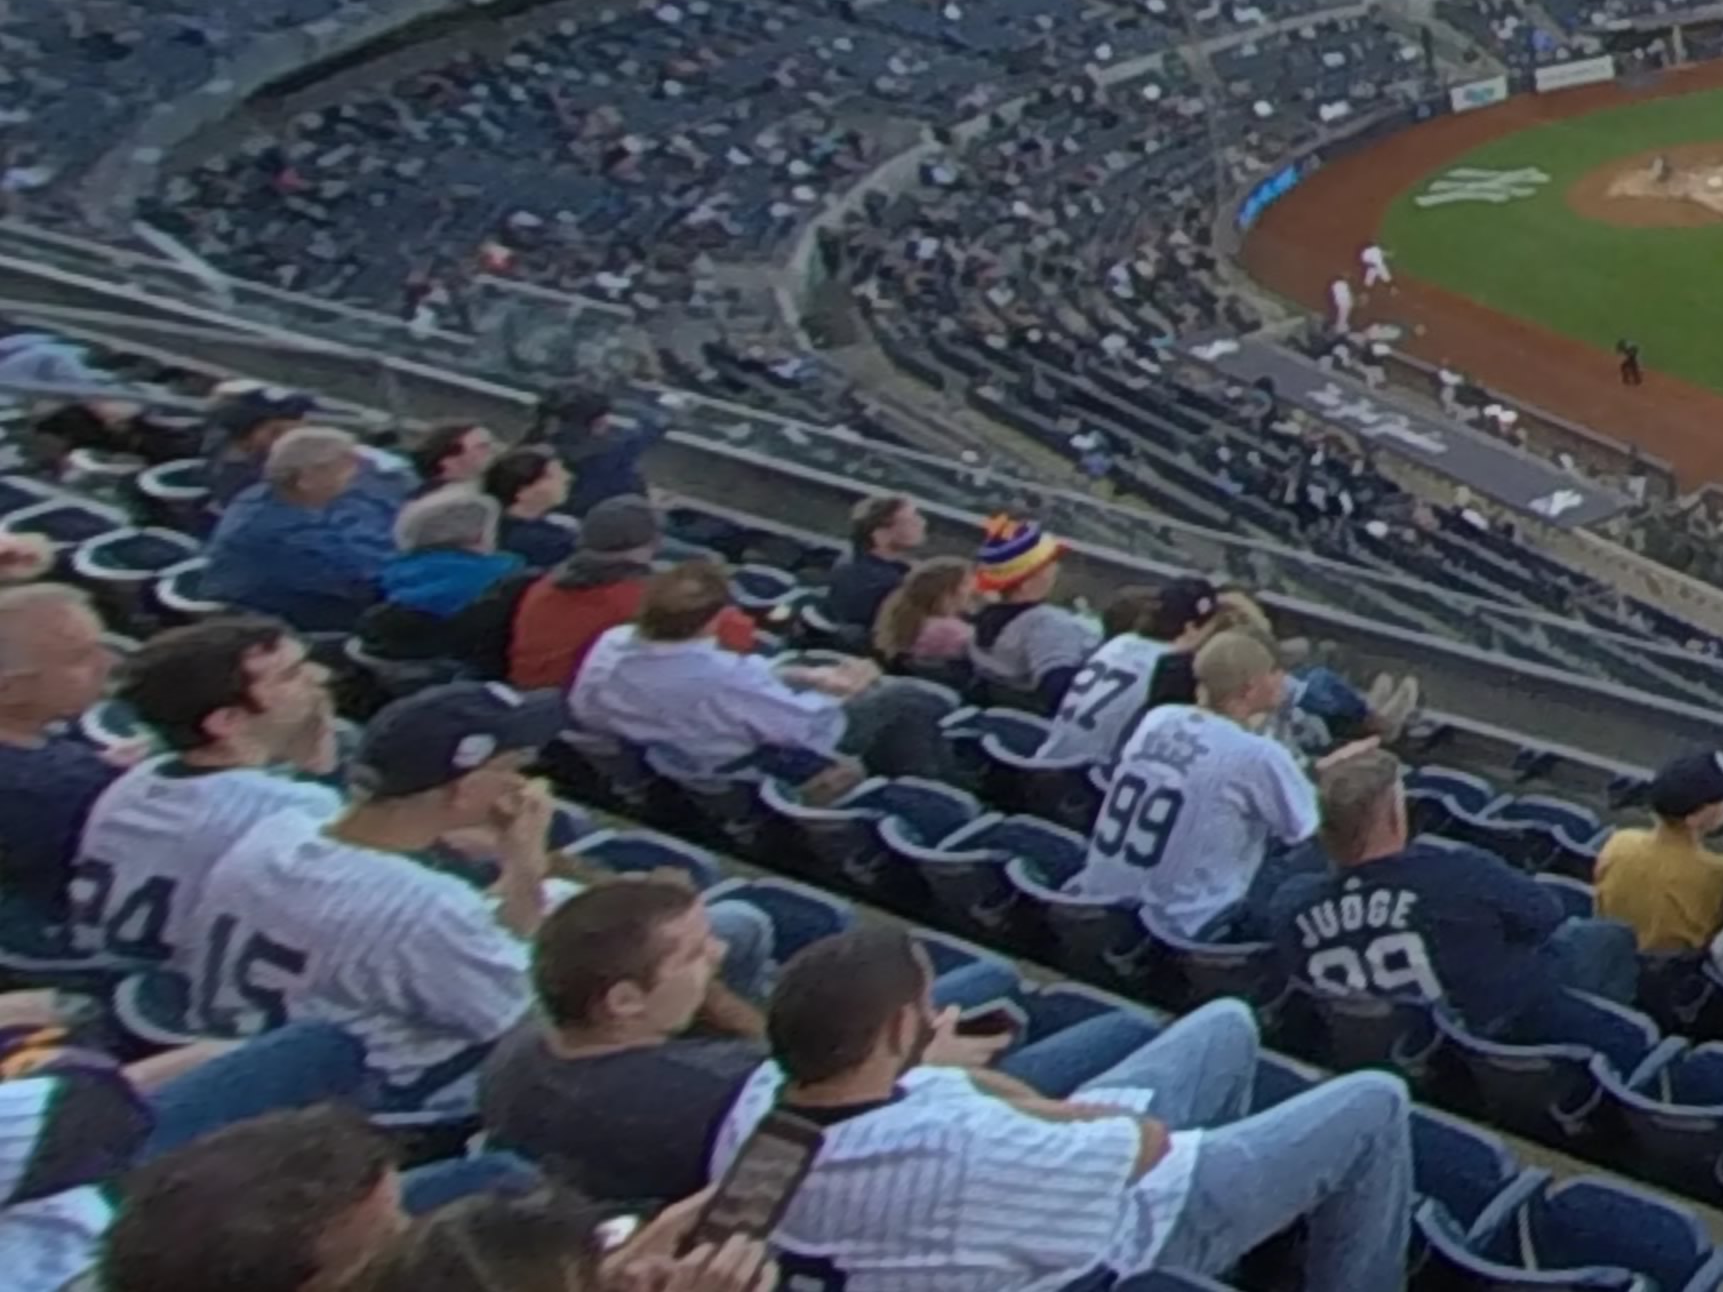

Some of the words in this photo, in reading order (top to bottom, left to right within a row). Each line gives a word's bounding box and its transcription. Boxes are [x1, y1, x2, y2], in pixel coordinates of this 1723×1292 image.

[1060, 659, 1138, 730] 27
[1096, 771, 1184, 868] 99
[1296, 889, 1417, 949] JUDGE
[199, 913, 307, 1037] 15
[1308, 932, 1443, 1001] 99
